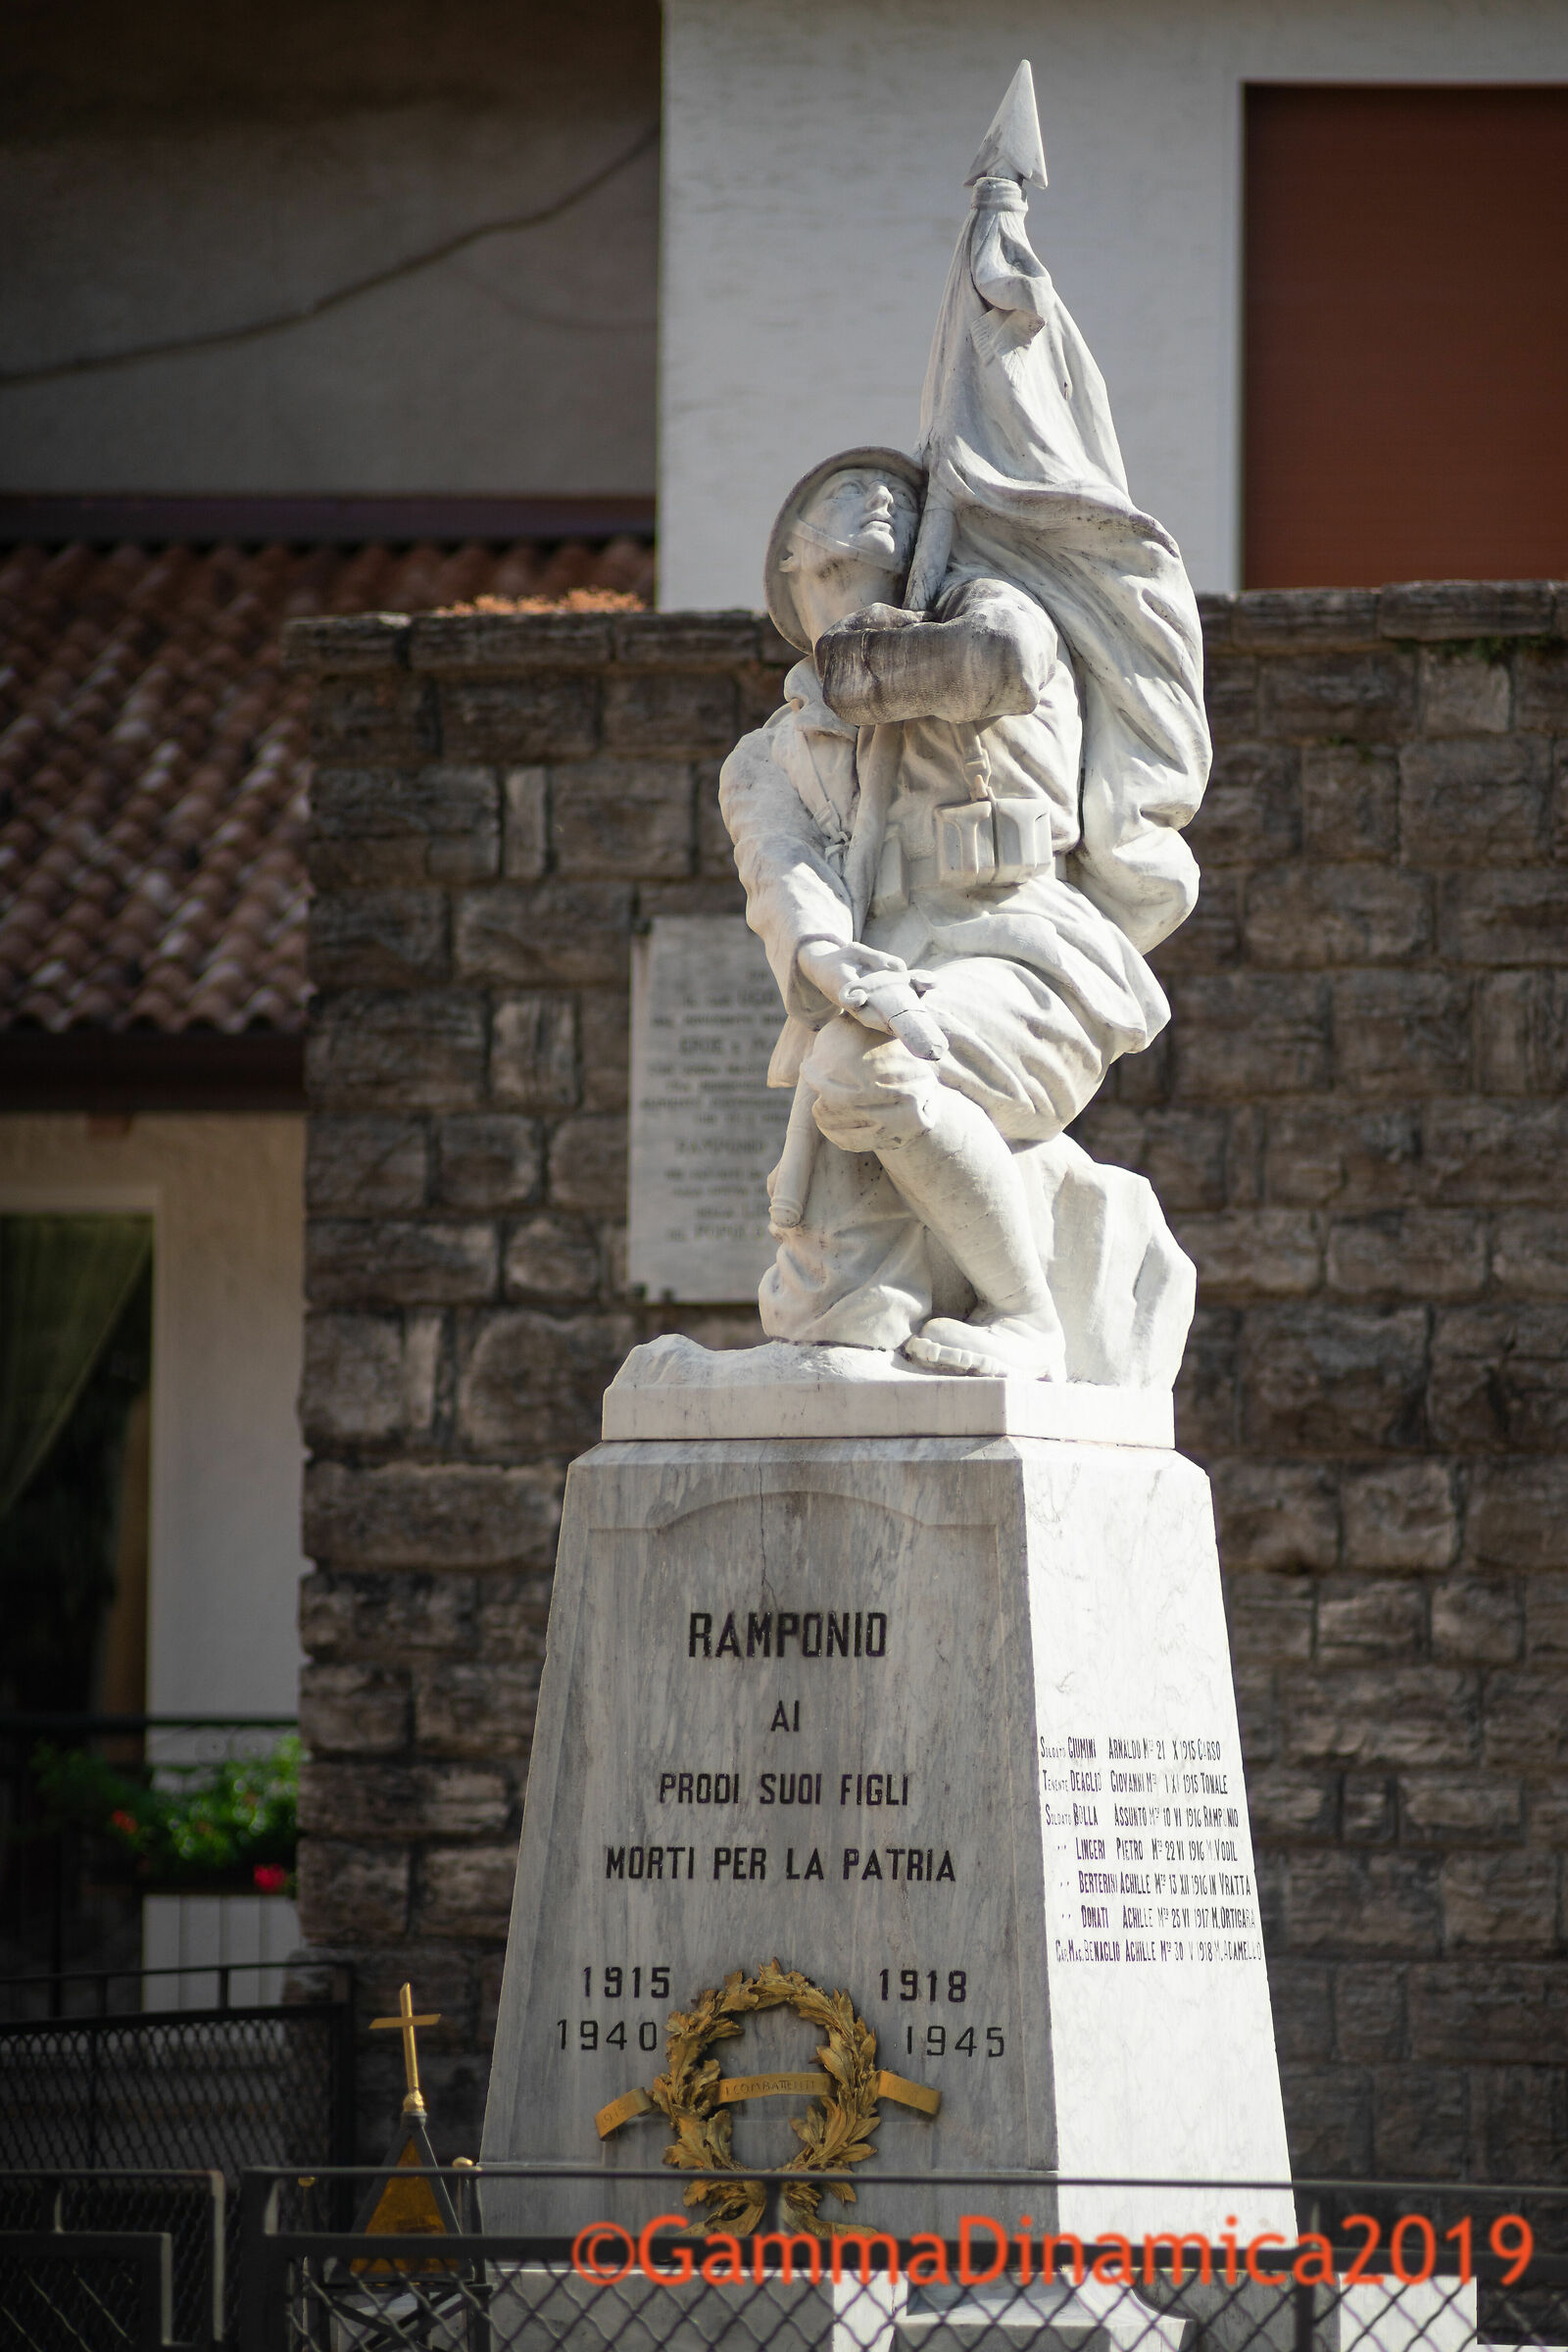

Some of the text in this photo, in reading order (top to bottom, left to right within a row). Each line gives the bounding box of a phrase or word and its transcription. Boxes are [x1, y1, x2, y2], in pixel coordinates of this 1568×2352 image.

[689, 1611, 887, 1657] RAMPONIO
[770, 1700, 801, 1732] AI
[1156, 1740, 1166, 1760] 21
[1172, 1740, 1179, 1760] X
[1180, 1740, 1197, 1760] 1915
[1198, 1739, 1221, 1761] CARSO
[660, 1773, 908, 1806] PRODI SUOI FIGLI
[1183, 1774, 1200, 1794] 1915
[1200, 1772, 1228, 1794] TONALE
[1114, 1803, 1148, 1827] ASSUNTO
[1162, 1807, 1171, 1827] 10
[1173, 1807, 1182, 1827] VI
[1186, 1807, 1201, 1828] 1916
[1203, 1805, 1239, 1828] RAMPONIO
[605, 1846, 956, 1882] MORTI PER LA PATRIA
[1076, 1838, 1105, 1860] LINGERI
[1116, 1838, 1144, 1861] PIETRO
[1164, 1839, 1175, 1861] 22
[1176, 1839, 1185, 1861] VI
[1188, 1839, 1204, 1861] 1916
[1120, 1872, 1151, 1894] ACHILLE
[1168, 1874, 1177, 1895] 13
[1191, 1874, 1208, 1895] 1916
[1218, 1872, 1251, 1895] VRATTA
[1081, 1905, 1109, 1928] DONATI
[1123, 1905, 1152, 1929] ACHILLE
[1172, 1909, 1181, 1929] 25
[1183, 1909, 1190, 1929] VI
[1194, 1908, 1209, 1929] 1917
[1125, 1939, 1156, 1962] ACHILLE
[584, 1967, 670, 1998] 1915
[879, 1969, 967, 2002] 1918
[557, 2020, 658, 2051] 1940
[906, 2026, 1004, 2058] 1945
